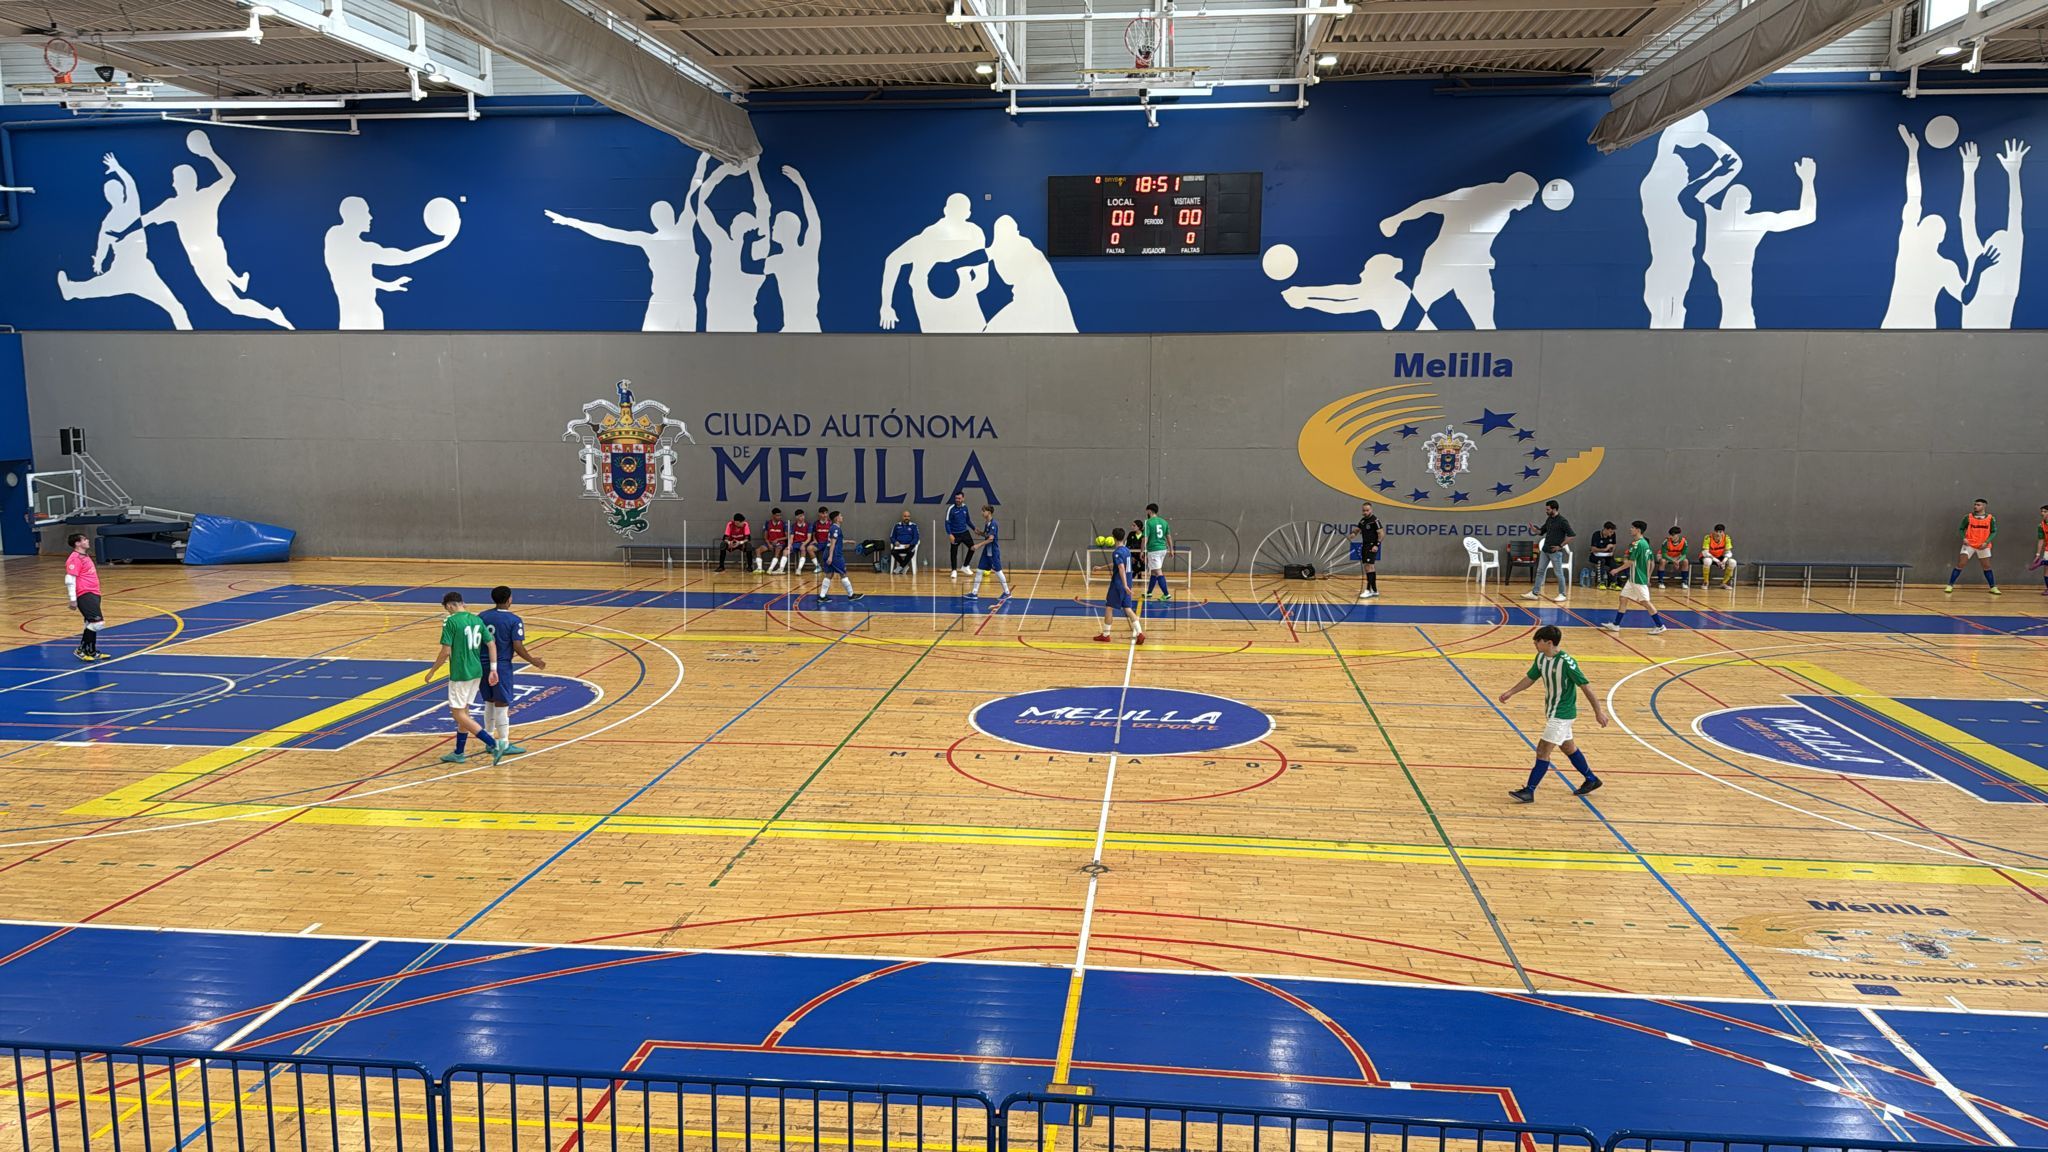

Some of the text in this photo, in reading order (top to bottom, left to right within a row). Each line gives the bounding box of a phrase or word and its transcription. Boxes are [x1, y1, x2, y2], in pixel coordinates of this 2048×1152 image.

[1135, 176, 1180, 193] 18:51
[1173, 197, 1201, 205] VISITANTE
[1111, 210, 1135, 226] 00
[1153, 205, 1159, 216] 1
[1178, 209, 1202, 225] 00
[1110, 232, 1120, 244] 0
[1186, 232, 1196, 244] 0
[1393, 352, 1514, 378] Melilla
[704, 412, 811, 437] CIUDAD
[820, 407, 999, 439] AUTÓNOMA
[733, 445, 750, 459] DE
[711, 446, 1002, 506] MELILLA
[1156, 524, 1164, 539] 5
[1385, 524, 1458, 537] EUROPEA
[1463, 524, 1492, 537] DEL
[464, 624, 482, 651] 16
[1018, 706, 1223, 725] MELILLA
[1014, 718, 1221, 731] CIUDAD DEL DEPORTE
[1761, 716, 1885, 765] MELILLA
[1807, 900, 1950, 917] Melilla
[1808, 970, 1888, 982] CIUDAD
[1890, 974, 1992, 985] EUROPEA
[1992, 979, 2036, 987] DEL
